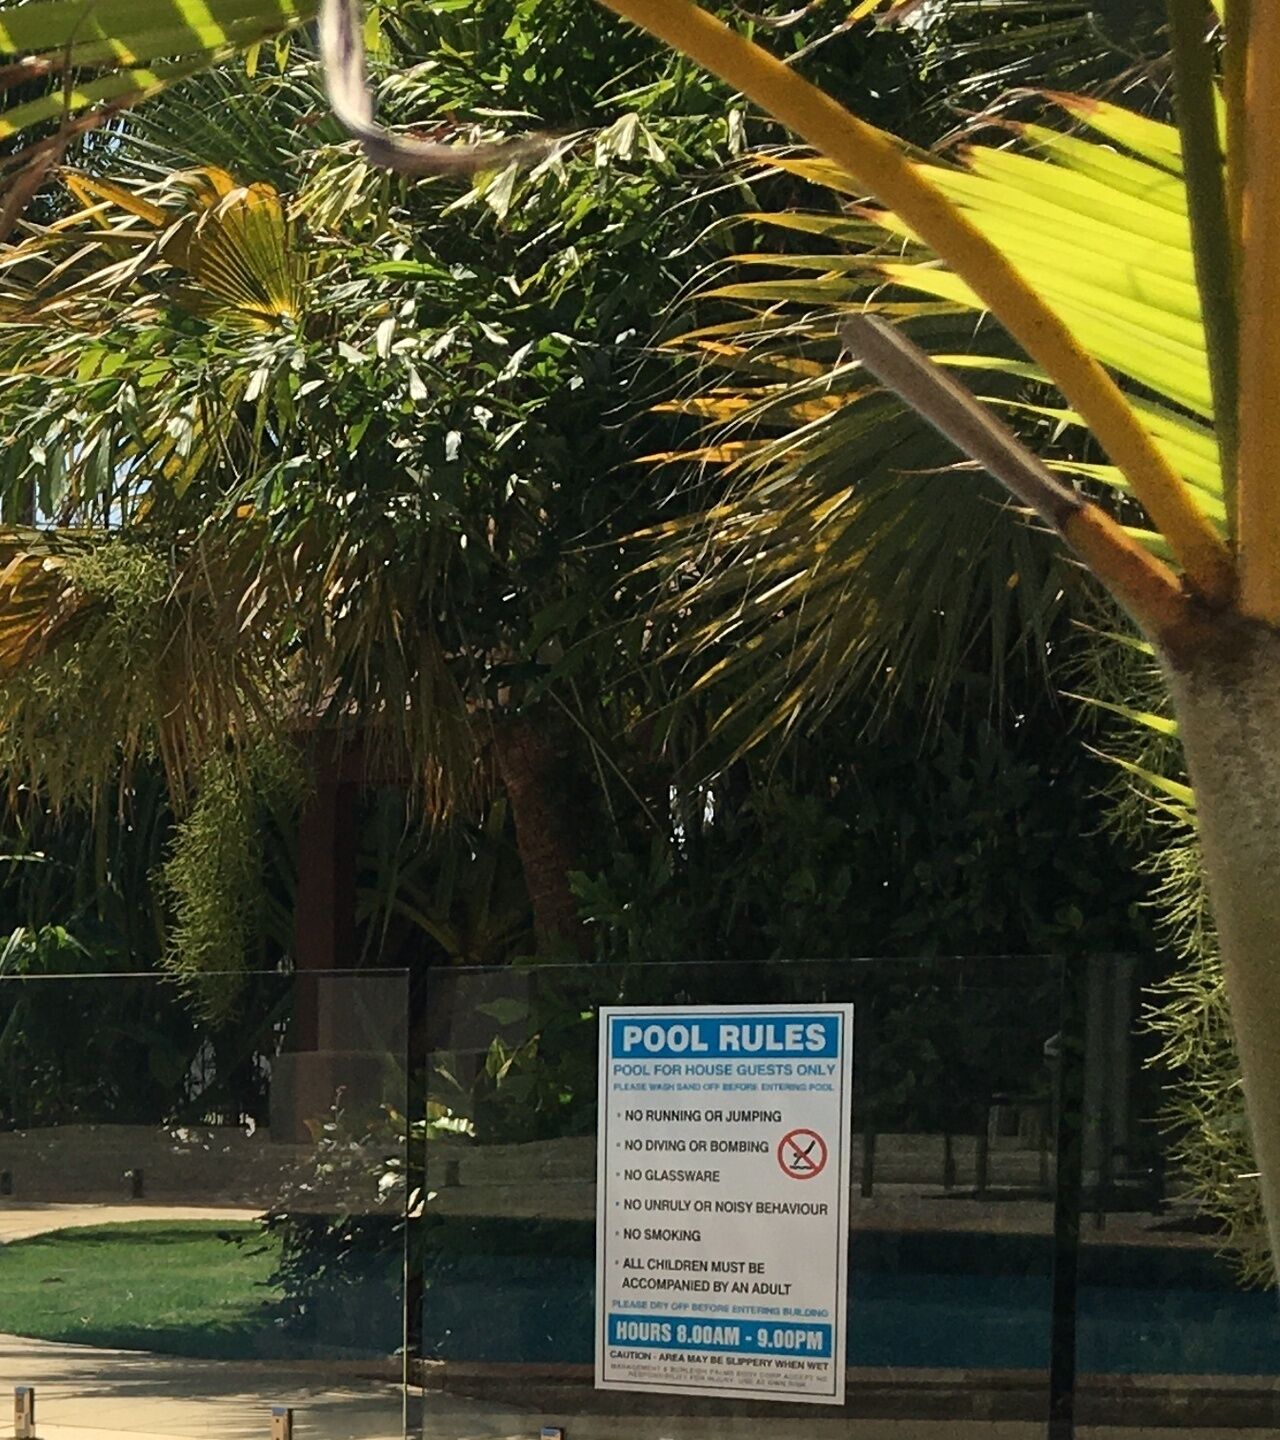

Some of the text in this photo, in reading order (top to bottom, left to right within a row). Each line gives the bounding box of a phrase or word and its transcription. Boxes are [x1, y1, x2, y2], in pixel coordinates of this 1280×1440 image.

[622, 1024, 826, 1052] POOL RULES
[613, 1064, 836, 1076] POOL FOR HOUSE GUESTS ONLY
[614, 1083, 646, 1091] PLEASE
[703, 1083, 720, 1091] OFF
[722, 1083, 757, 1091] BEFORE
[761, 1083, 806, 1091] ENTERING
[809, 1083, 833, 1091] POOL
[625, 1110, 782, 1123] NO RUNNING OR JUMPING
[624, 1140, 769, 1153] NO DIVING OR BOMBING
[624, 1170, 720, 1182] NO GLASSWARE
[624, 1199, 828, 1215] NO UNRULY OR NOISY BEHAVIOUR
[624, 1228, 701, 1242] NO SMOKING
[623, 1258, 765, 1274] ALL CHILDREN MUST BE
[622, 1278, 792, 1296] ACCOMPANIED BY AN ADULT
[612, 1300, 829, 1318] PLEASE DRY OFF BEFORE ENTERING BUILDING
[616, 1320, 671, 1342] HOURS
[676, 1324, 740, 1346] 8.00AM
[757, 1328, 823, 1350] 9.00PM
[610, 1351, 651, 1362] CAUTION
[659, 1352, 684, 1363] AREA
[688, 1354, 708, 1364] MAY
[711, 1355, 724, 1365] BE
[726, 1356, 772, 1368] SLIPPERY
[775, 1360, 805, 1370] WHEN
[807, 1362, 829, 1371] WET
